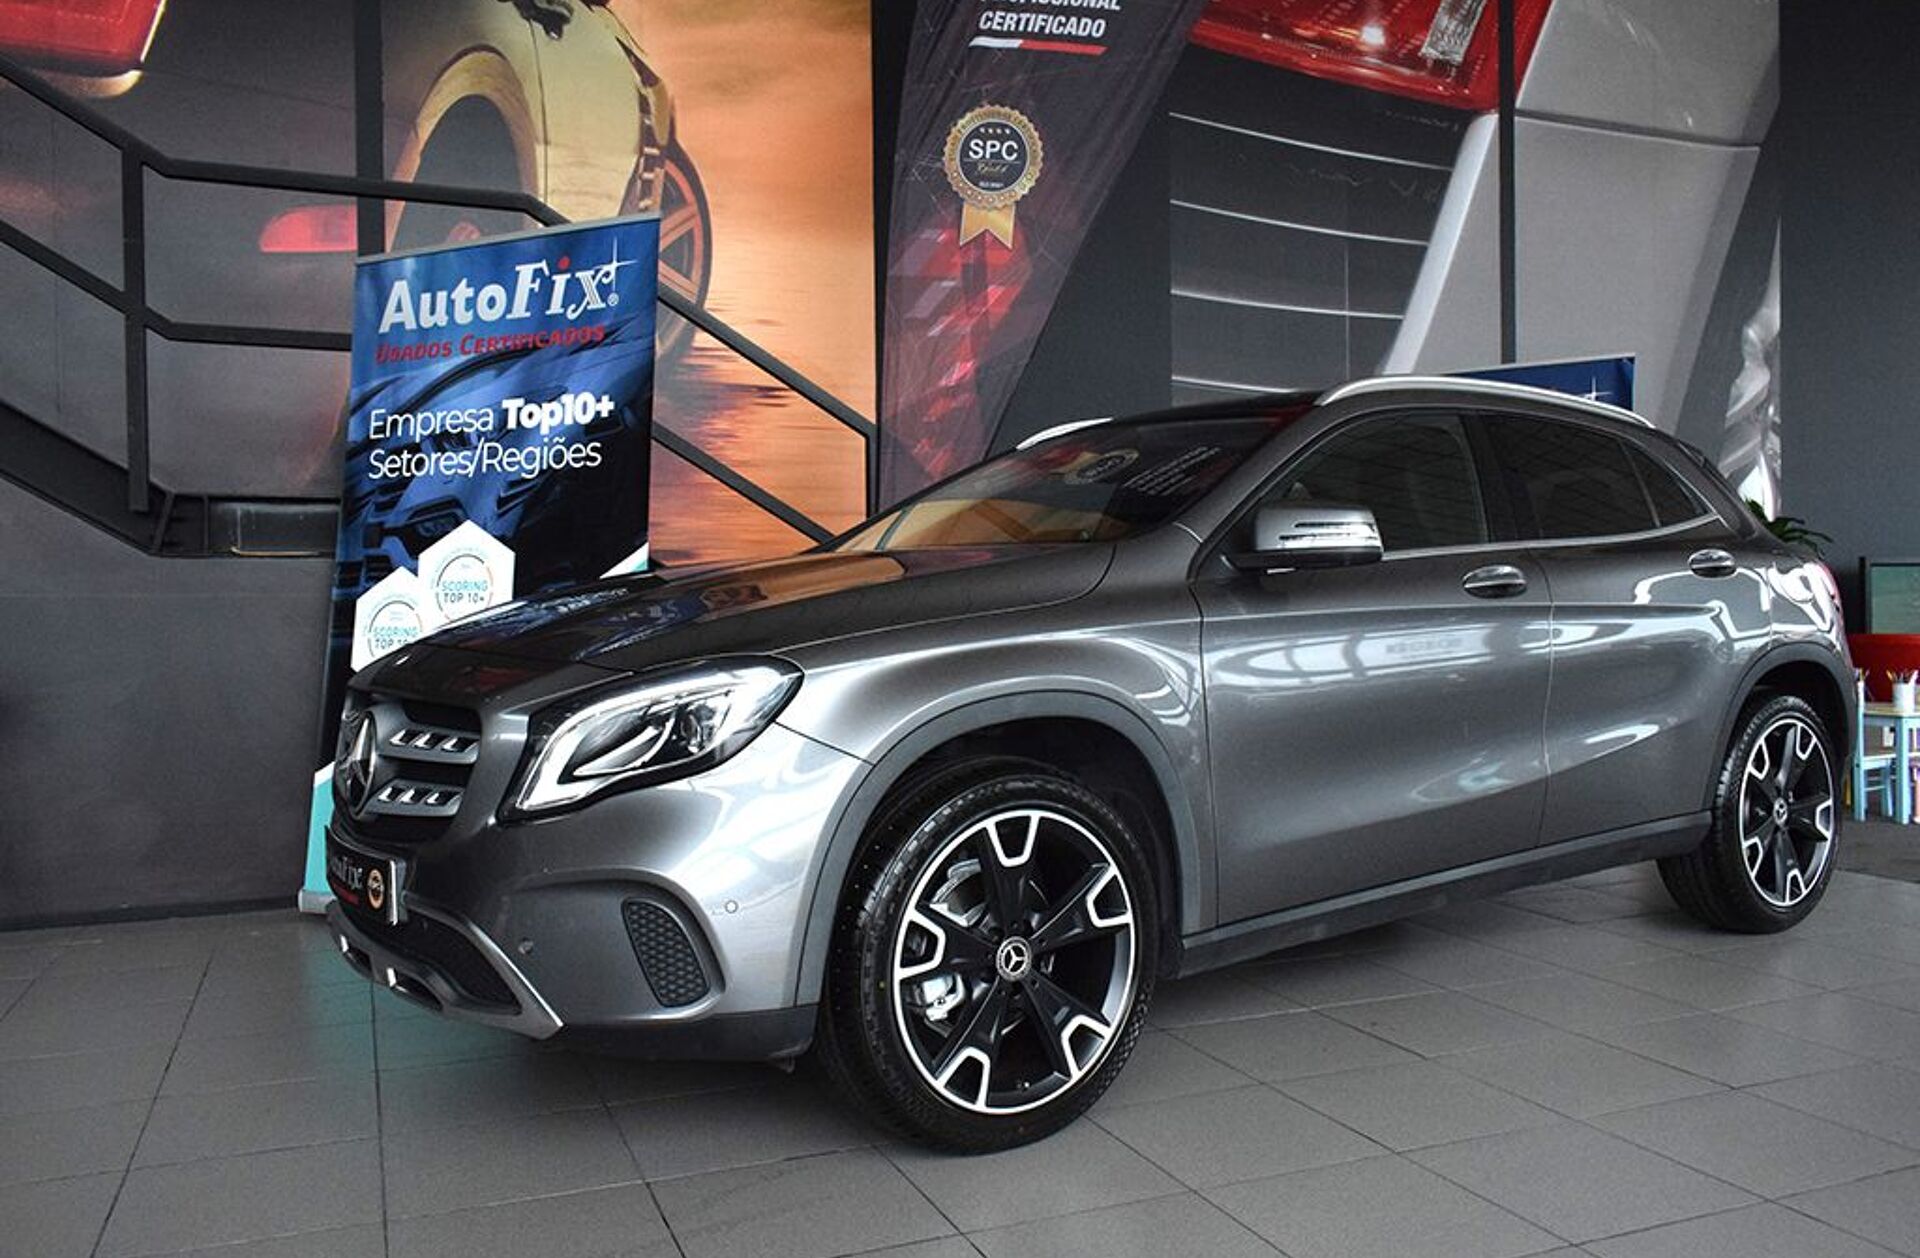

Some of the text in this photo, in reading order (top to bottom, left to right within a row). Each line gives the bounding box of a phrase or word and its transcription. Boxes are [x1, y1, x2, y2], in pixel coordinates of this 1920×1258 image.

[979, 10, 1106, 38] CERTIFICADO
[968, 138, 1019, 161] SPC
[368, 391, 615, 443] Empresa Top10+
[367, 436, 603, 480] Setores/Regiões
[442, 580, 488, 592] SCORING
[443, 592, 464, 603] TOP
